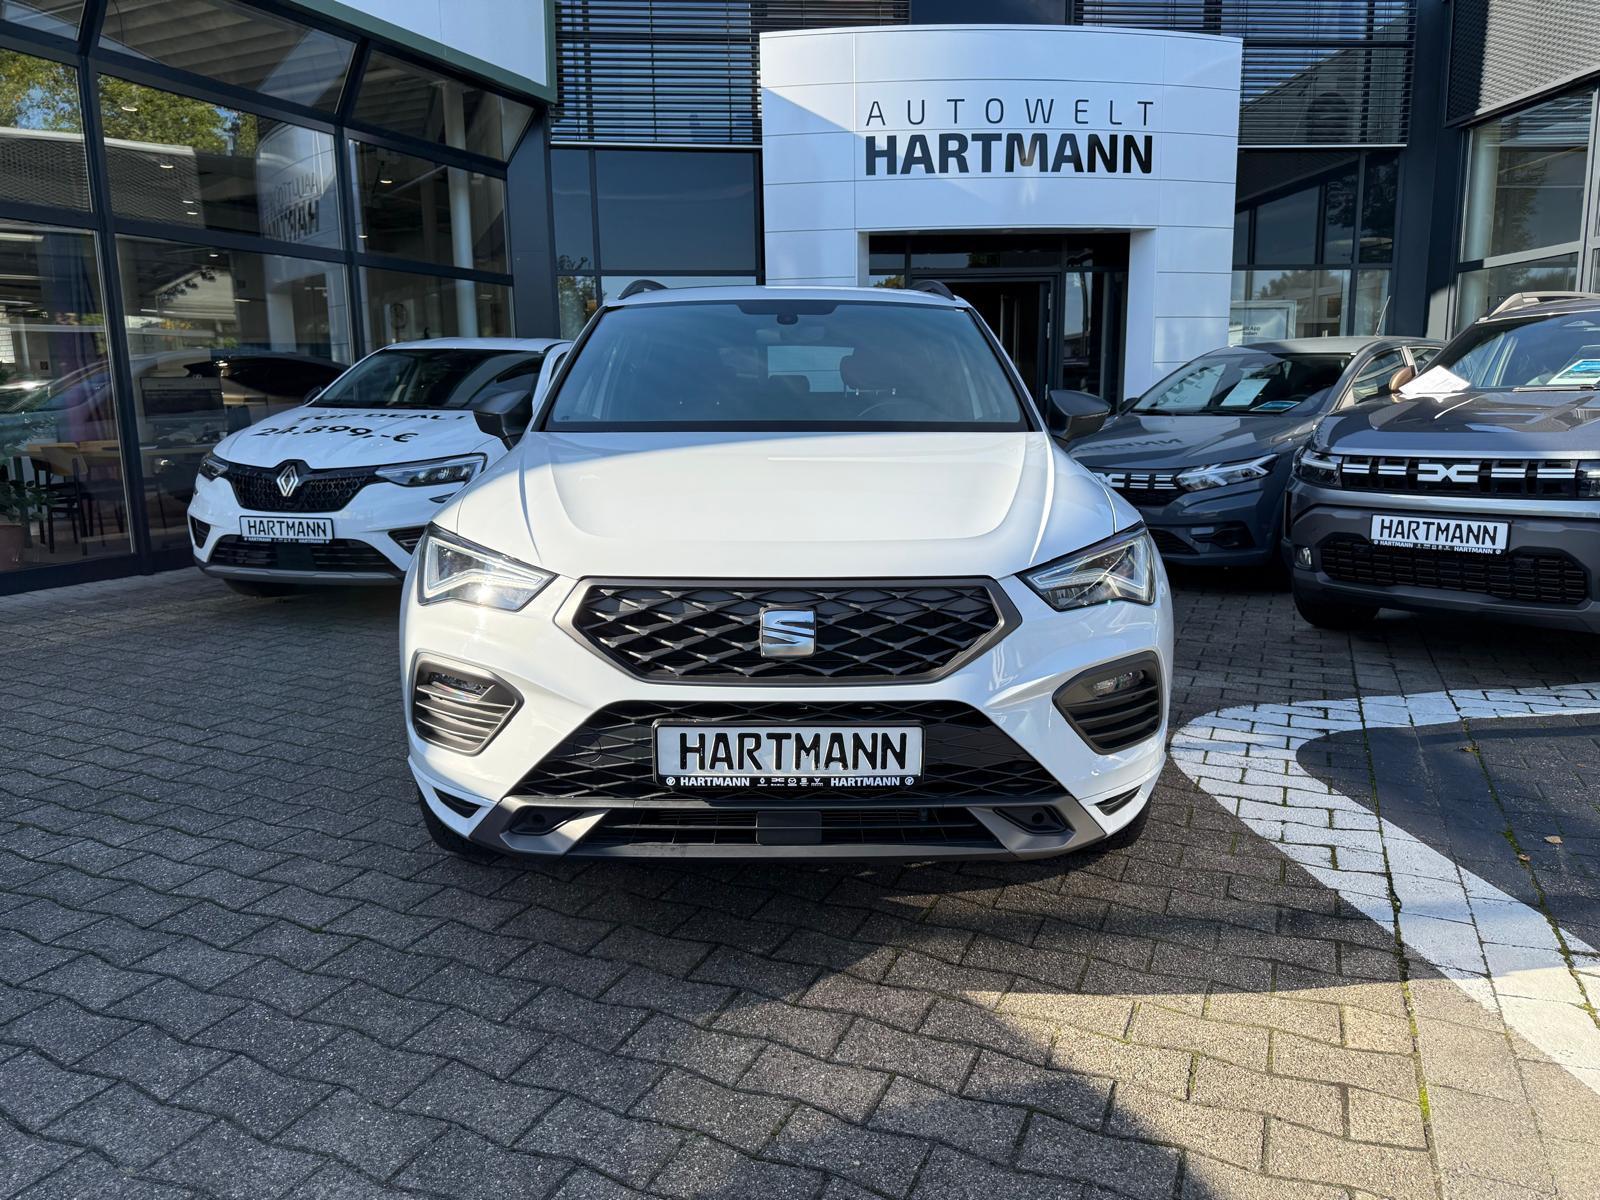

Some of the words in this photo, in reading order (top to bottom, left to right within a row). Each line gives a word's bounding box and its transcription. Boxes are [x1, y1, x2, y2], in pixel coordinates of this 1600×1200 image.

[866, 98, 1154, 126] AUTOWELT
[865, 133, 1153, 176] HARTMANN
[247, 519, 327, 537] HARTMANN
[1379, 518, 1498, 546] HARTMANN
[1379, 540, 1413, 549] HARTMANN
[1454, 545, 1493, 555] HARTMANN
[679, 732, 908, 771] HARTMANN
[680, 776, 750, 787] HARTMANN
[830, 776, 900, 787] HARTMANN
